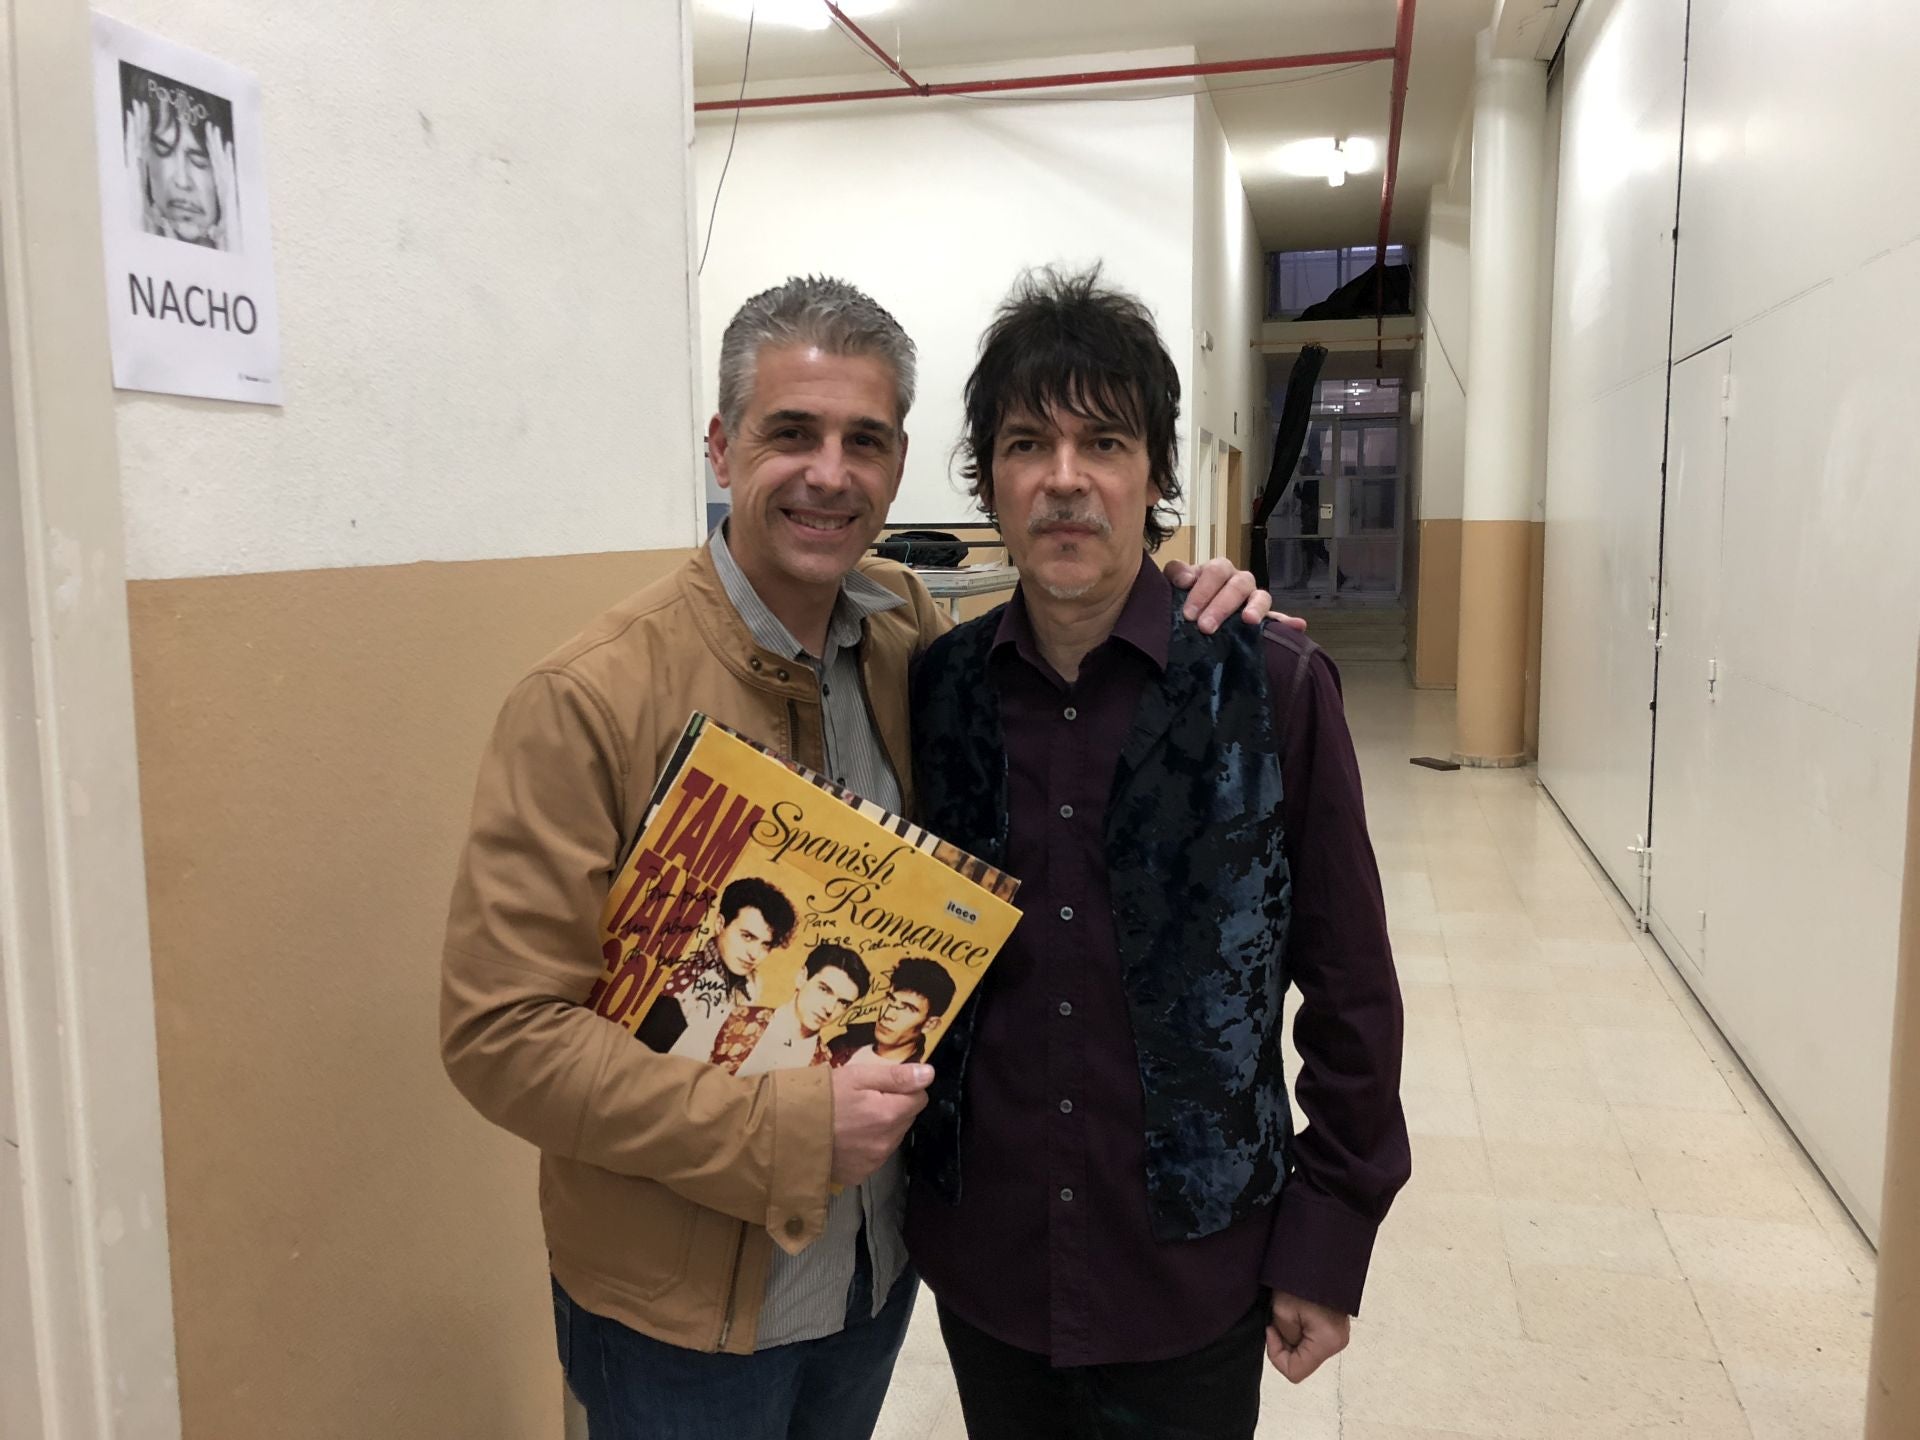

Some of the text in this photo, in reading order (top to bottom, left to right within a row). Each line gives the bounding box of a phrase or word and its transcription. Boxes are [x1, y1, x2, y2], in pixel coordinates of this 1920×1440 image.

[127, 271, 258, 335] NACHO
[652, 766, 766, 890] TAM
[749, 800, 915, 885] Spanish
[607, 848, 718, 963] TAM
[806, 876, 989, 969] Romance
